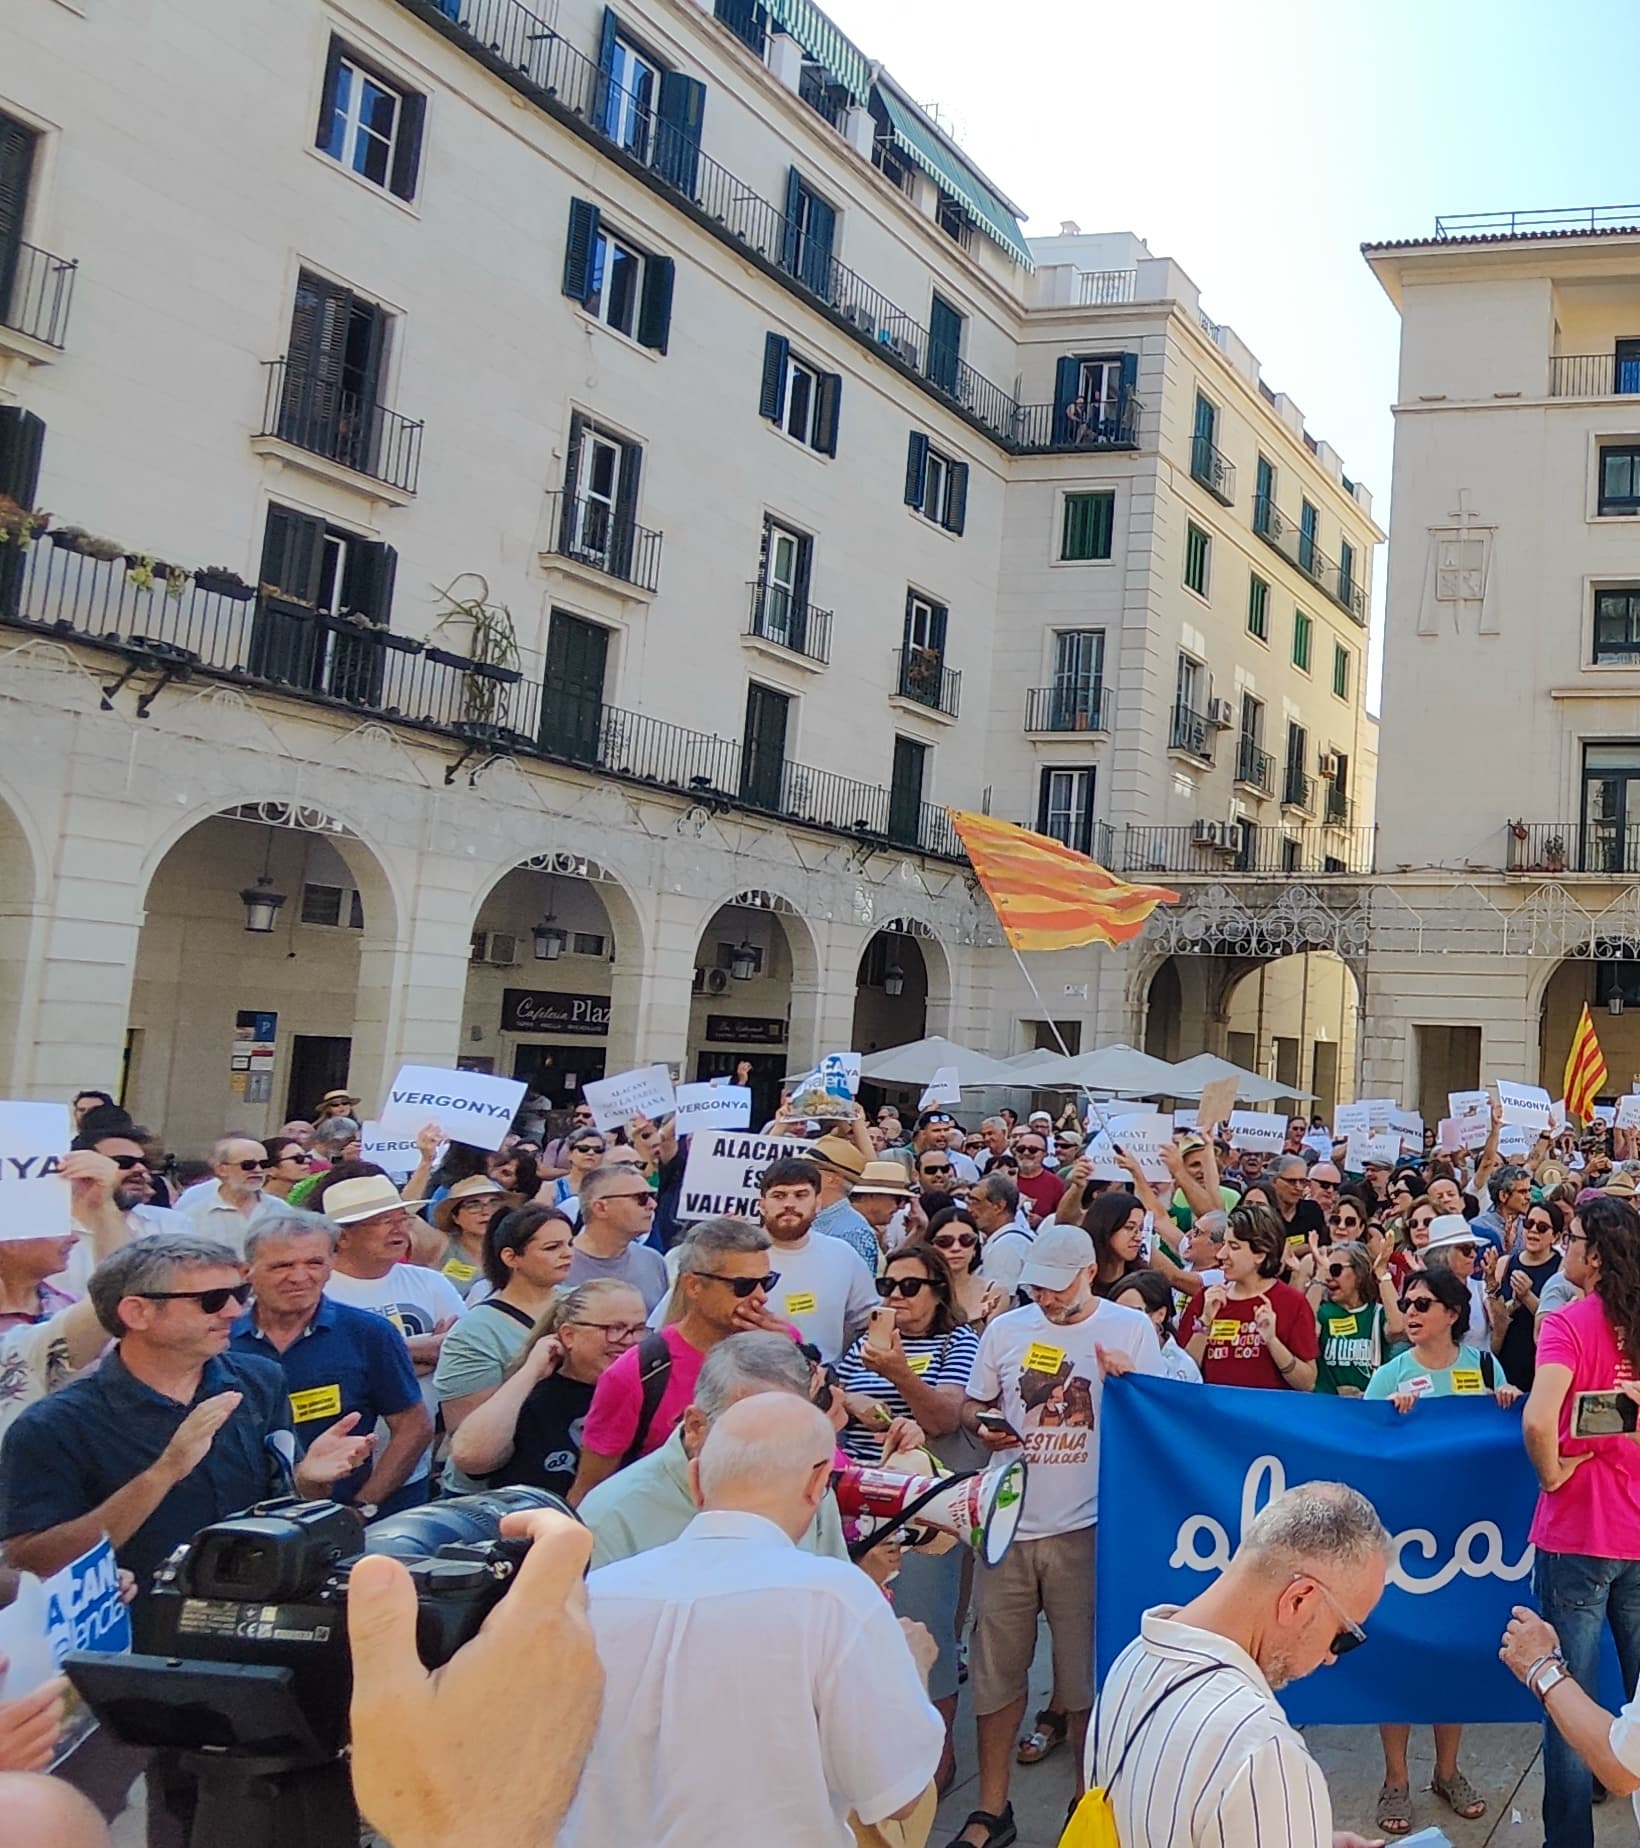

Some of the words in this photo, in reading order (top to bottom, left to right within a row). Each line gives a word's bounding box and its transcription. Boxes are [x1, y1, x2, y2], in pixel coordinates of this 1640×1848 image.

[571, 1000, 611, 1024] Plaz
[392, 1091, 511, 1121] VERGONYA
[678, 1101, 749, 1114] VERGONYA
[1501, 1096, 1550, 1111] VERGONYA
[1229, 1126, 1284, 1139] VERGONYA
[686, 1193, 761, 1218] VALENC
[1025, 1432, 1087, 1451] ESTIMA
